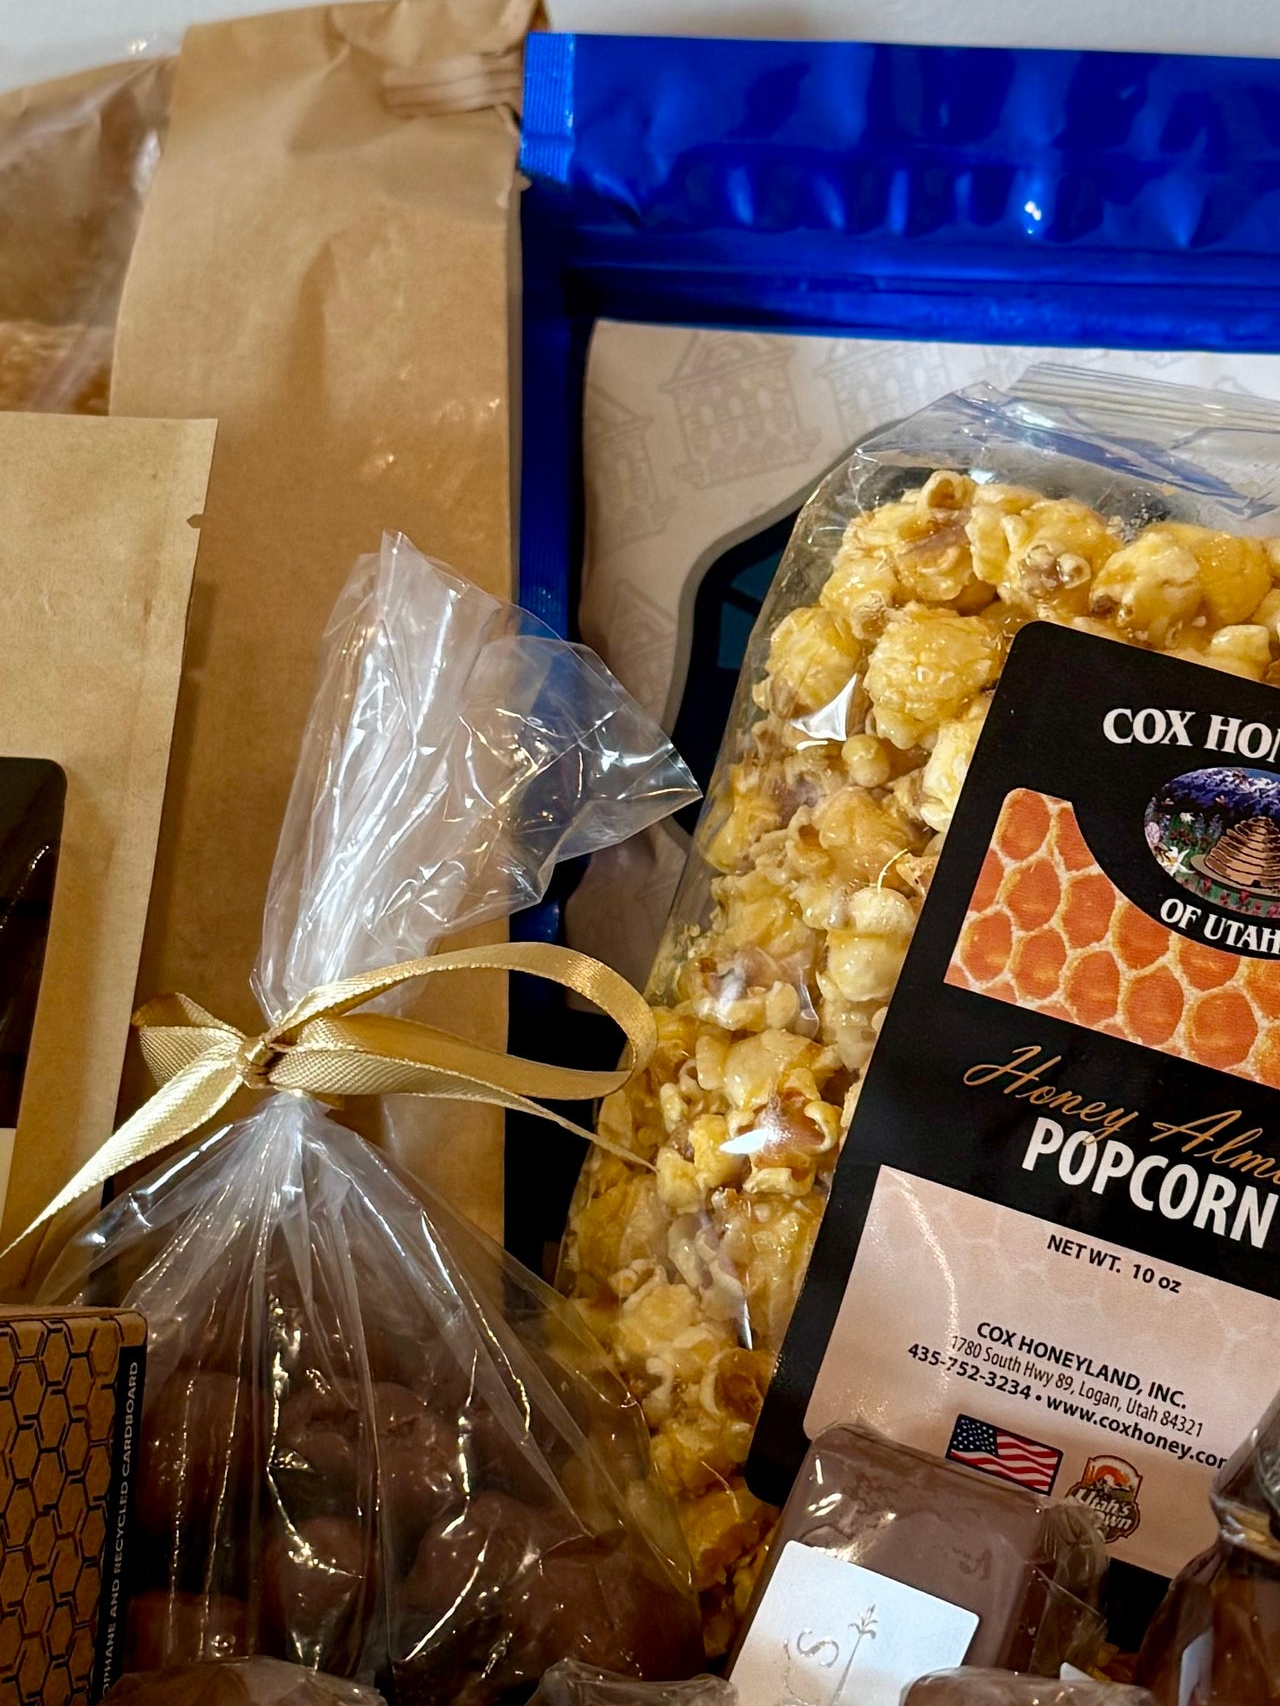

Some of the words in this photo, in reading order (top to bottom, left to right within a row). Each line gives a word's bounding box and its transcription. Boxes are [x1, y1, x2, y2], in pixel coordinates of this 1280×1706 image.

[1102, 708, 1196, 746] COX
[1160, 898, 1200, 930] OF
[963, 1045, 1139, 1146] Honey
[1022, 1116, 1280, 1249] POPCORN
[1047, 1234, 1087, 1259] NET
[1088, 1249, 1122, 1274] WT.
[1131, 1263, 1156, 1285] 10
[1158, 1275, 1183, 1294] oz
[908, 1342, 1032, 1400] 435-752-3234
[951, 1334, 982, 1360] 1780
[984, 1346, 1022, 1374] South
[1022, 1363, 1054, 1389] Hwy
[1055, 1373, 1074, 1396] 89,
[1078, 1381, 1122, 1413] Logan,
[1126, 1397, 1158, 1423] Utah
[1160, 1409, 1204, 1439] 84321
[977, 1321, 1017, 1348] COX
[1018, 1335, 1144, 1396] HONEYLAND,
[1147, 1381, 1187, 1410] INC.
[122, 1362, 138, 1477] CARDBOARD
[114, 1481, 129, 1574] RECYCLED
[109, 1579, 120, 1619] AND
